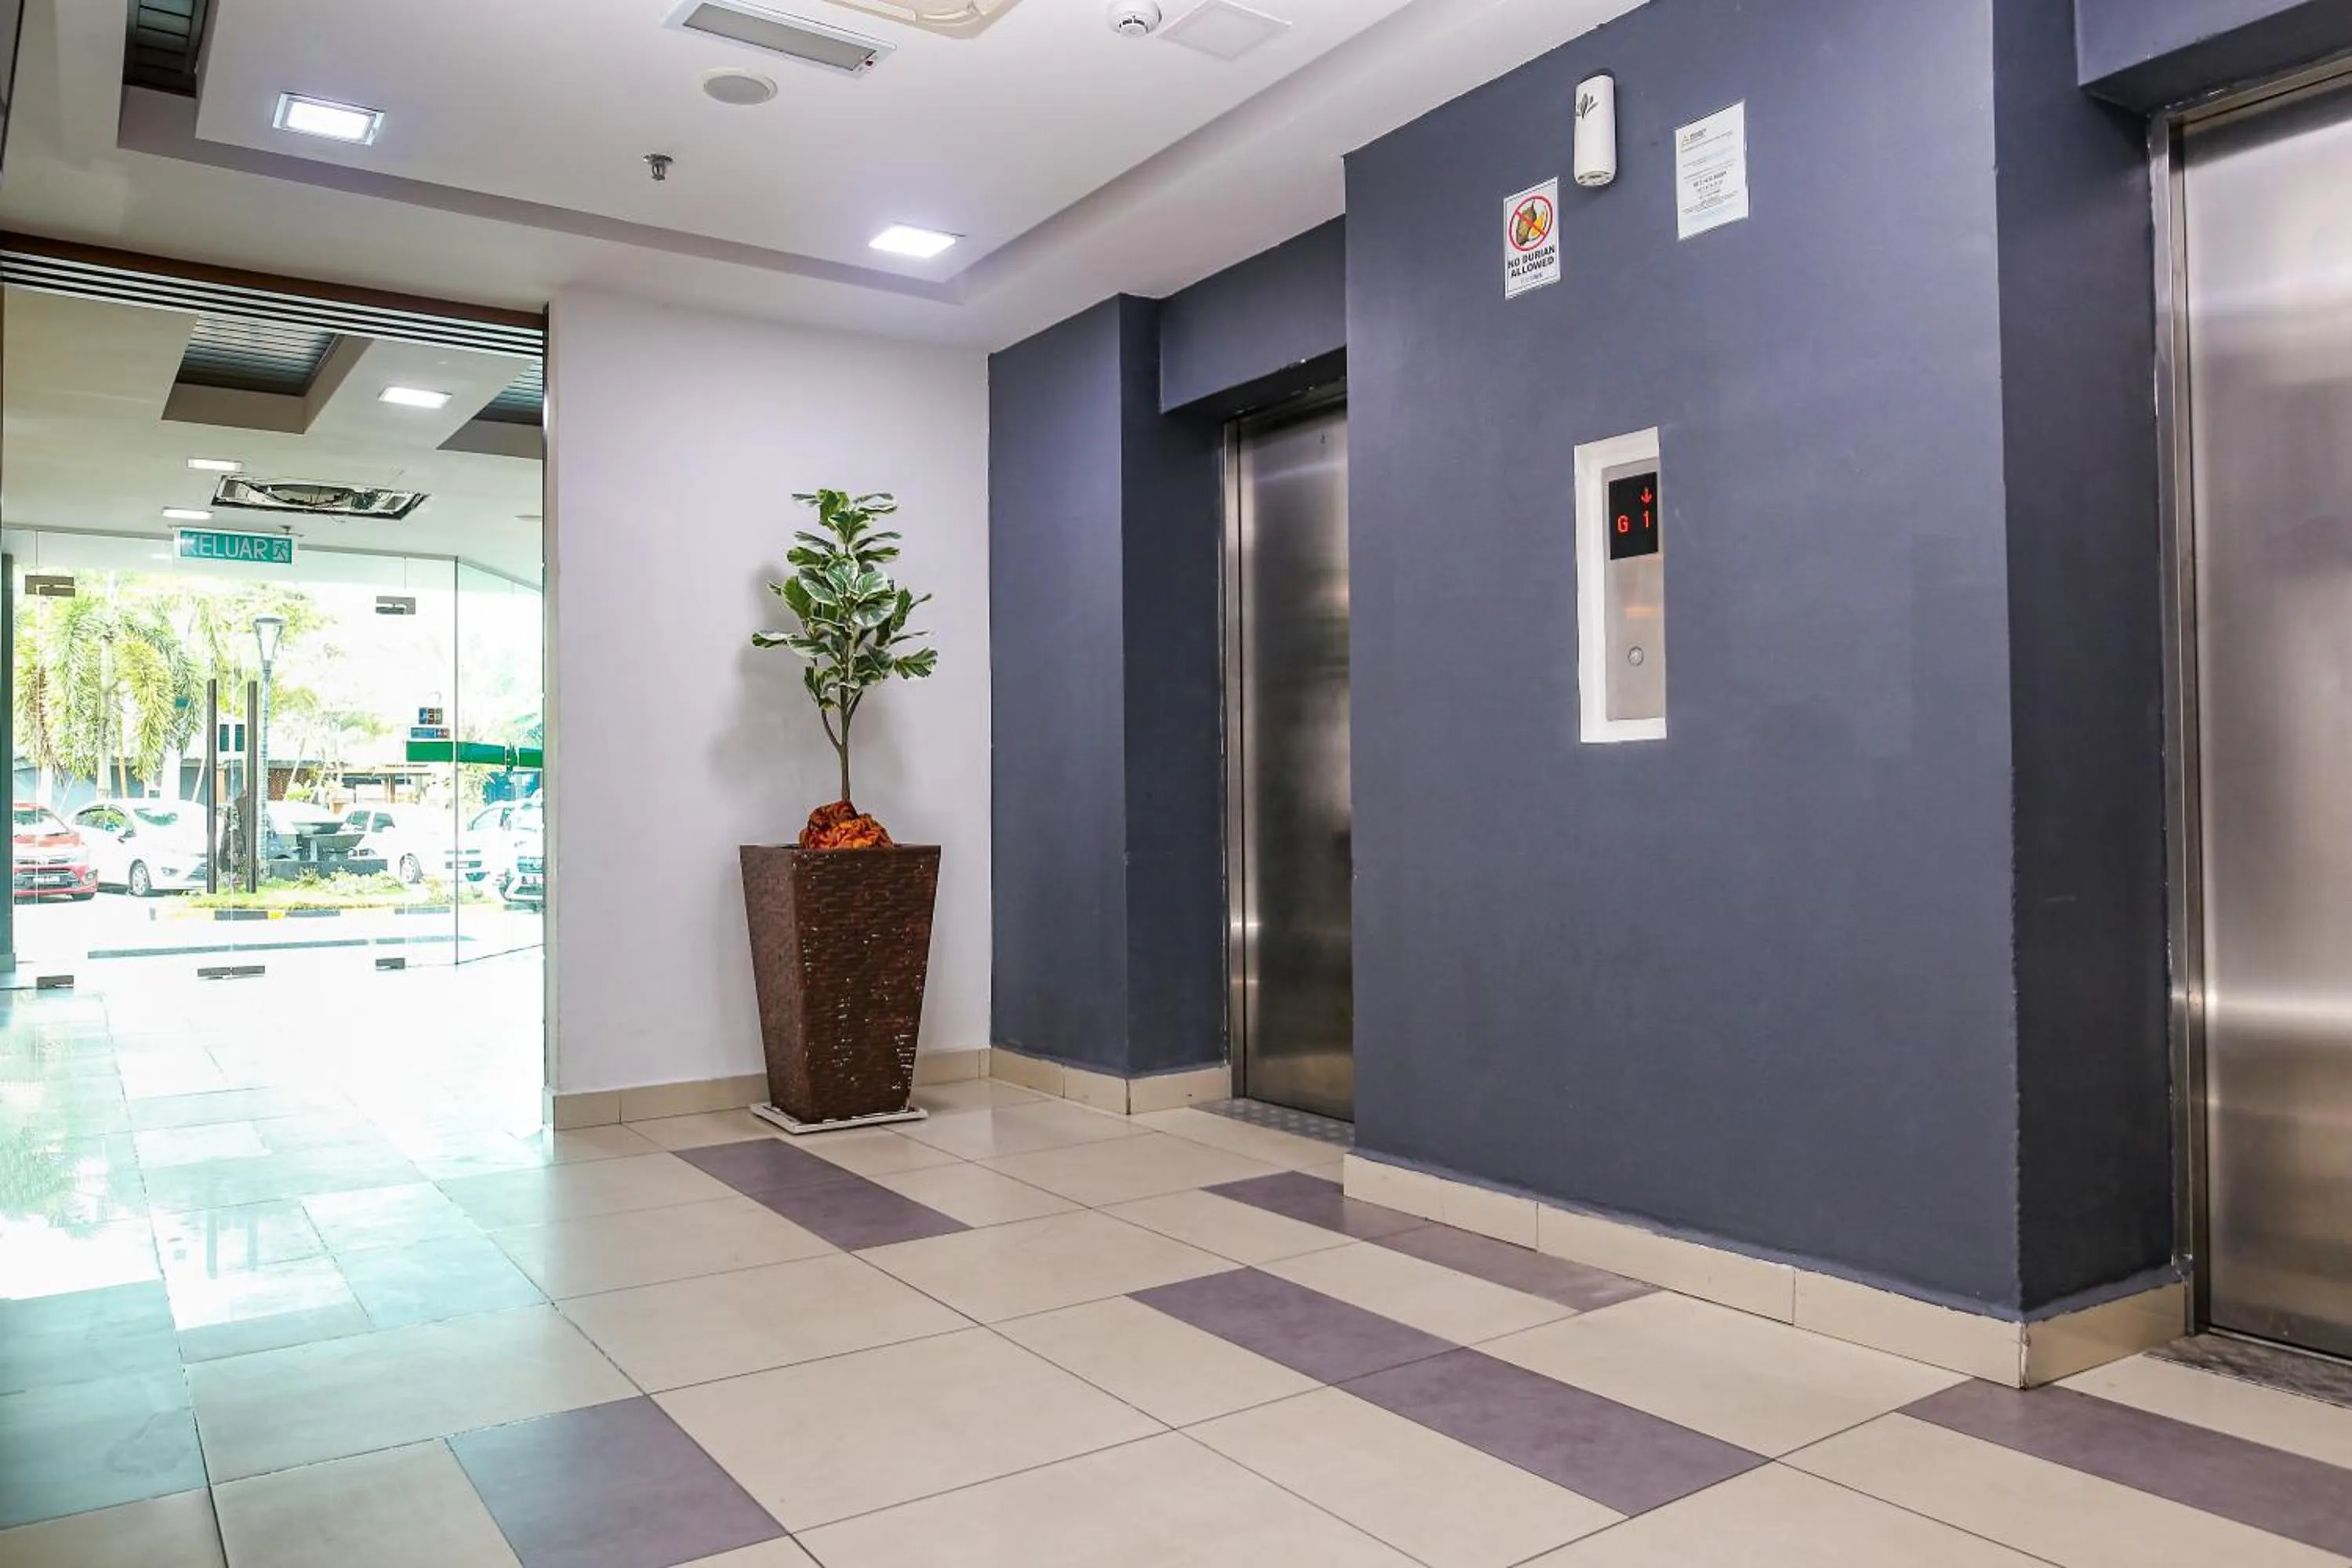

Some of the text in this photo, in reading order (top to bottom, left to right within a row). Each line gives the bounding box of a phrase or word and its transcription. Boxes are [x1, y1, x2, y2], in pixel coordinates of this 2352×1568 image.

[1508, 245, 1555, 268] NO DURIAN
[1511, 256, 1554, 277] ALLOWED
[1617, 510, 1649, 533] G 1
[181, 533, 267, 560] KELUAR
